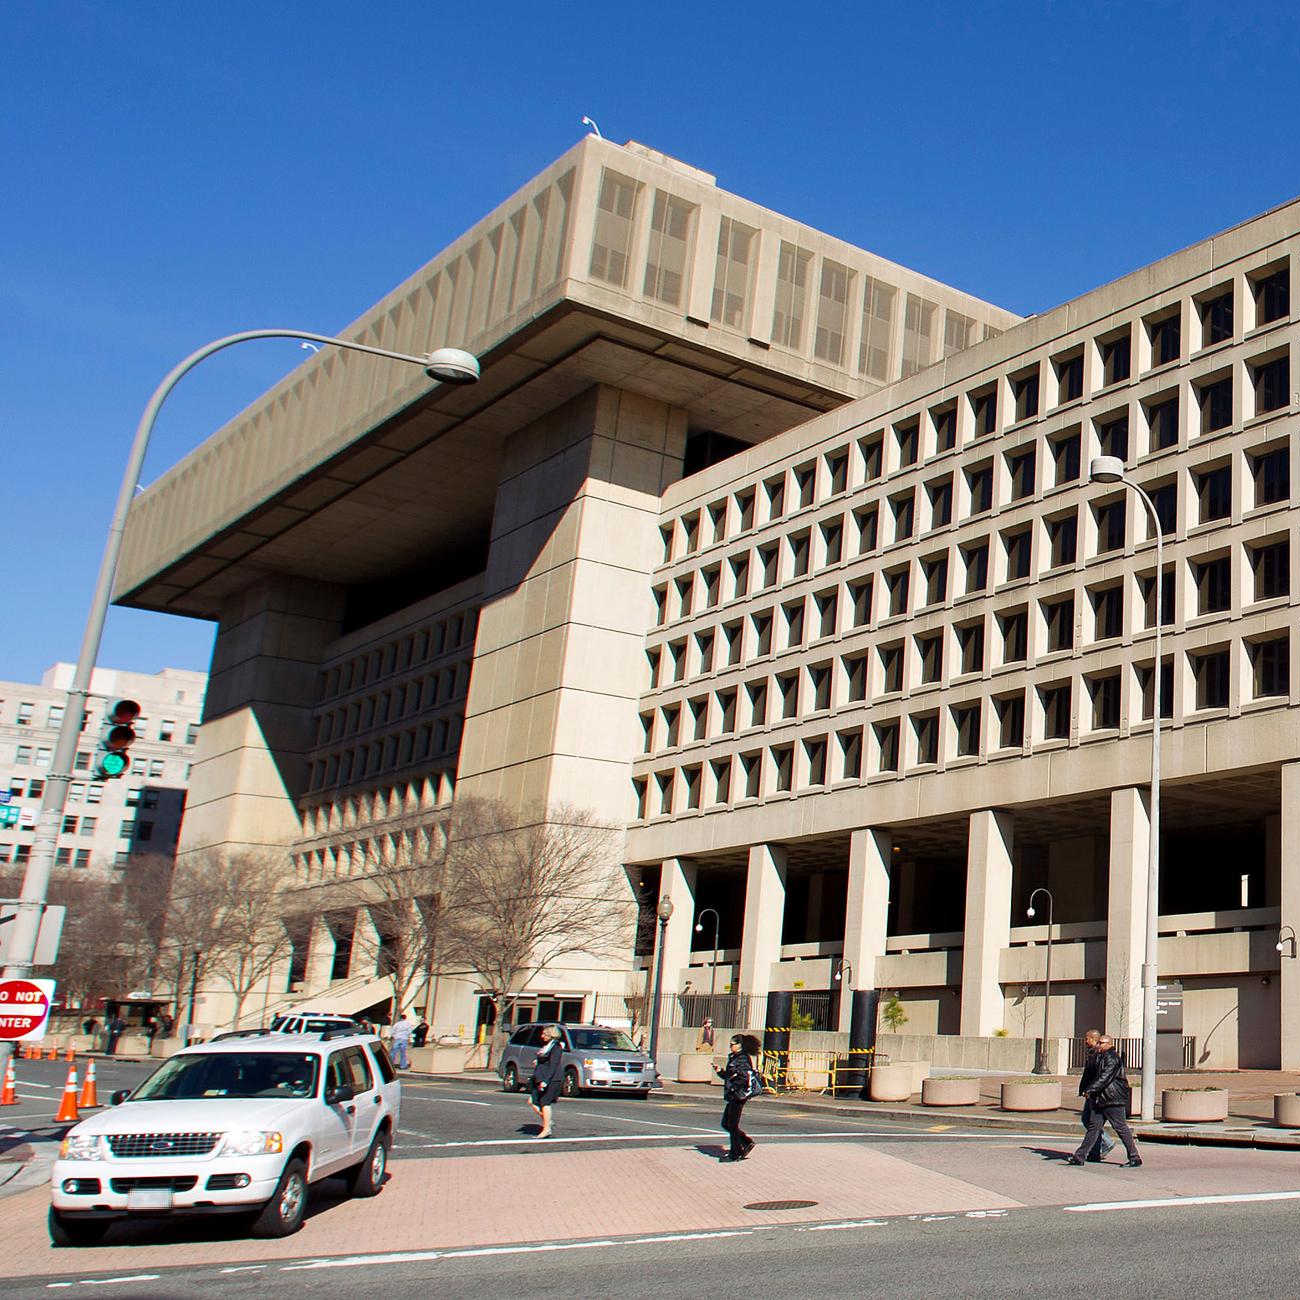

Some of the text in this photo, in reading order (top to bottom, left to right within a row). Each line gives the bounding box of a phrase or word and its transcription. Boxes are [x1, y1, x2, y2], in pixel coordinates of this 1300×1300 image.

[0, 991, 43, 1002] O NOT
[0, 1017, 32, 1028] NTER
